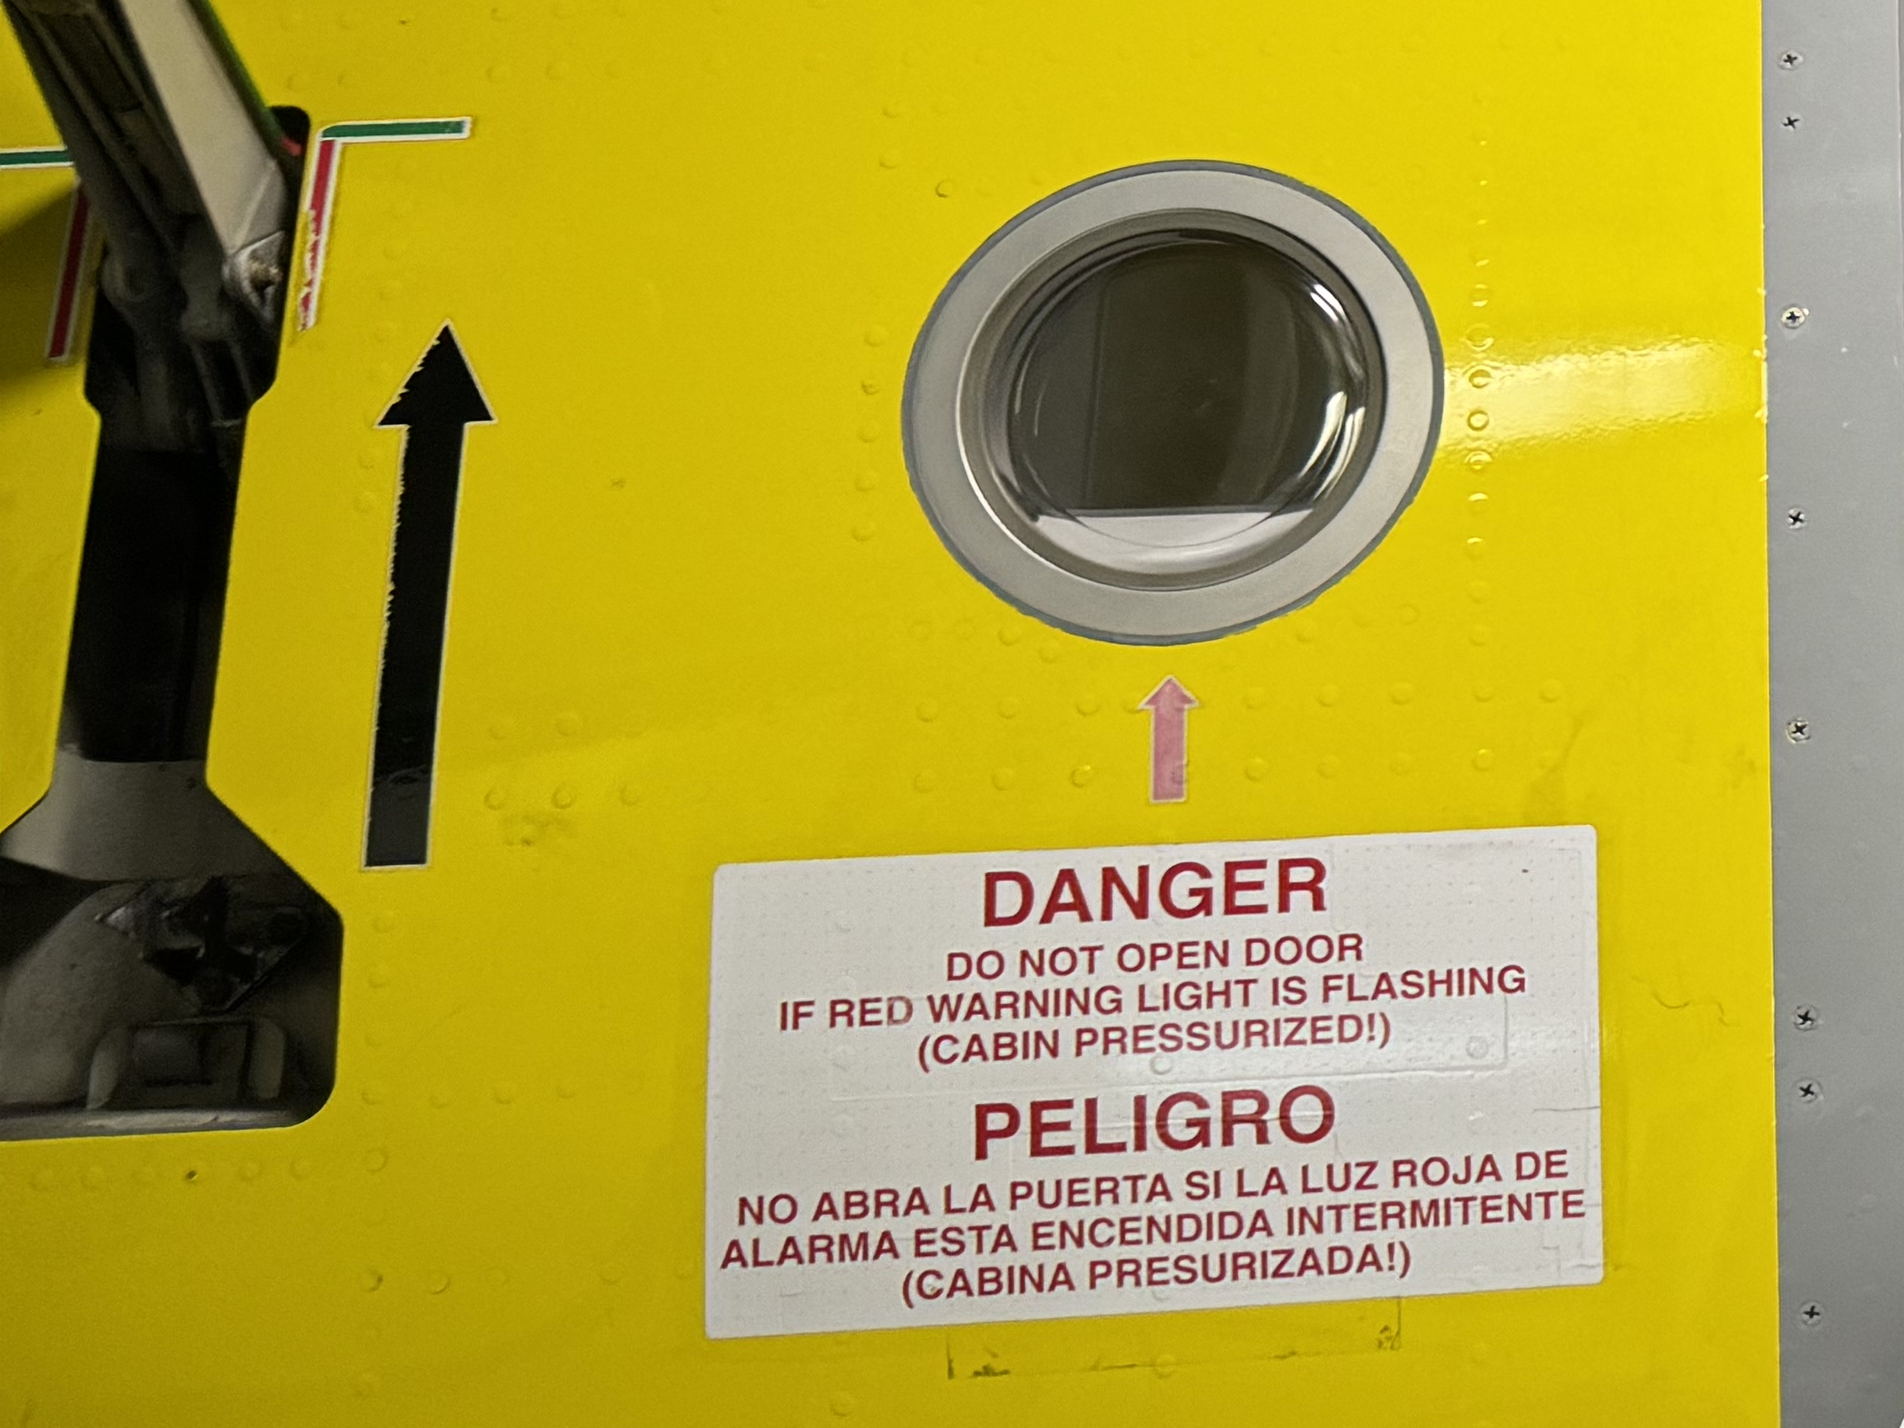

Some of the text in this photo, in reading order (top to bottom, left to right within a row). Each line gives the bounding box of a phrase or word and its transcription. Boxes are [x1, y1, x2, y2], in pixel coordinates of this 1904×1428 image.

[982, 856, 1328, 929] DANGER
[946, 933, 1364, 982] DO NOT OPEN DOOR
[779, 964, 1528, 1032] IF RED WARNING LIGHT IS FLASHING
[917, 1013, 1392, 1074] (CABIN PRESSURIZED!)
[974, 1084, 1337, 1163] PELIGRO
[737, 1149, 1569, 1227] NO ABRA LA PUERTA SI LA LUZ ROJA DE
[720, 1189, 1586, 1270] ALARMA ESTA ENCENDIDA INTERMITENTE
[901, 1242, 1412, 1308] (CABINA PRESURIZADA!)
